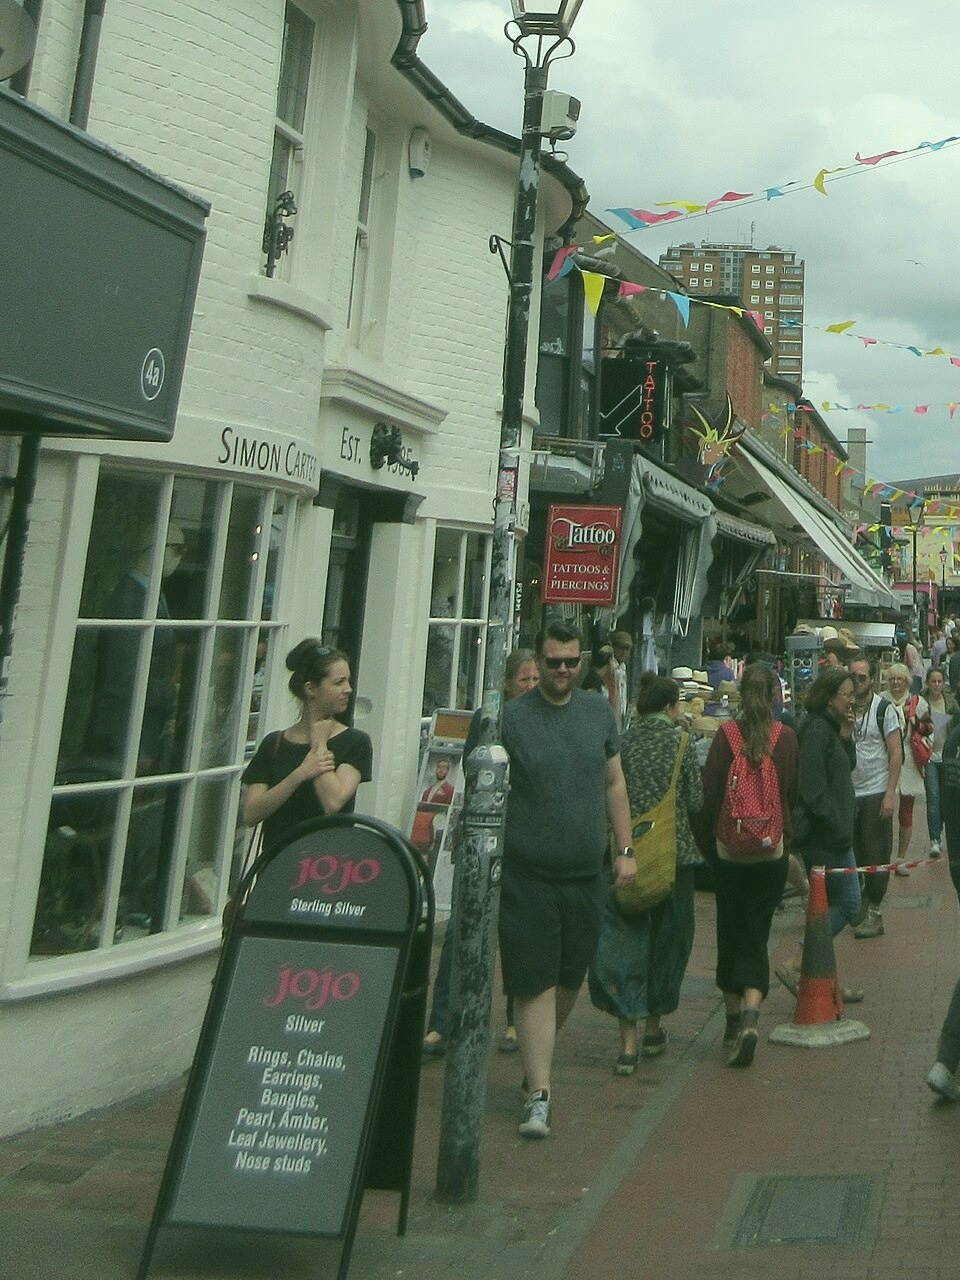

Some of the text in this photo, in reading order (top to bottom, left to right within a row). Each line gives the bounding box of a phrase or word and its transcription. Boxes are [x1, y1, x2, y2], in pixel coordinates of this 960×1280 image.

[145, 359, 161, 387] 4a
[640, 361, 657, 439] TATTOO
[217, 426, 282, 473] SIMON
[340, 426, 362, 465] EST.
[550, 517, 616, 549] Tattoo
[552, 563, 611, 575] TATTOOS &
[550, 579, 610, 591] PIERCINGS
[290, 898, 367, 917] Sterling Silver
[285, 1015, 326, 1033] Silver
[247, 1045, 346, 1071] Rings, Chains,
[262, 1067, 323, 1091] Earrings,
[261, 1088, 319, 1111] Bangles,
[237, 1107, 329, 1133] Pearl, Amber,
[228, 1129, 328, 1156] Leaf Jewellery,
[234, 1151, 312, 1173] Nose studs
